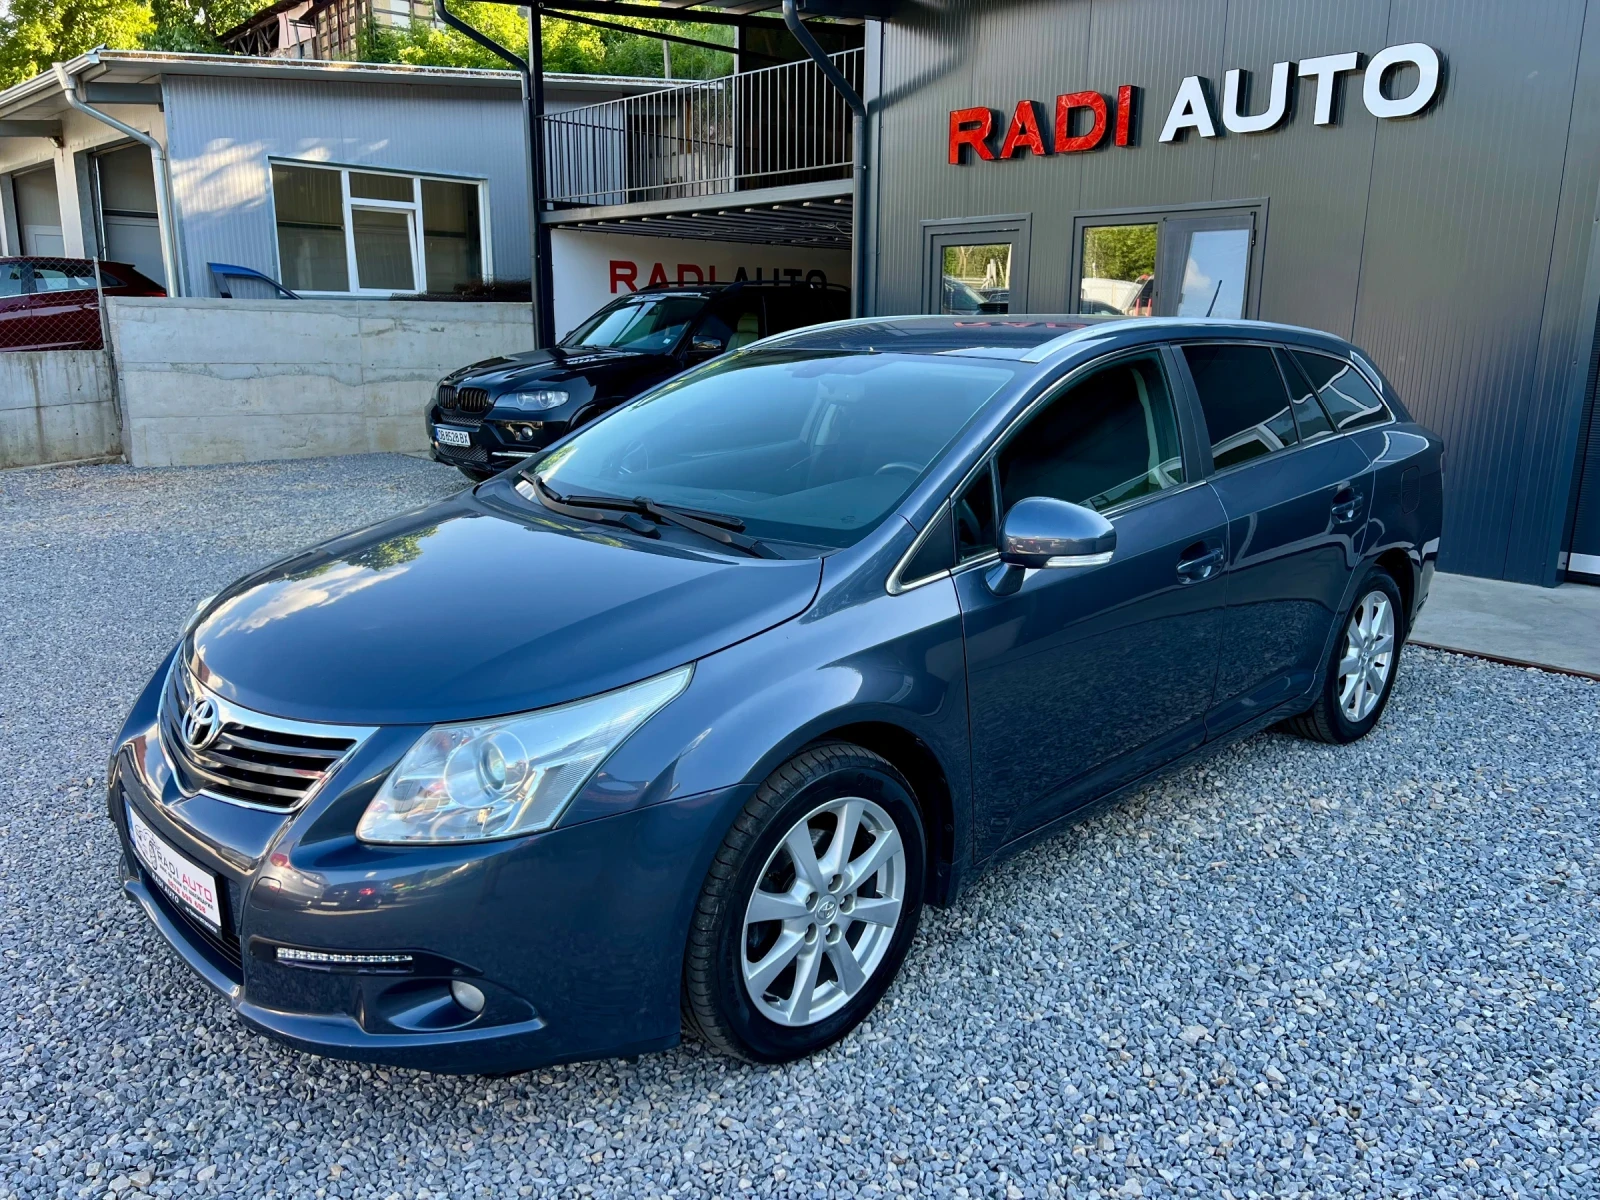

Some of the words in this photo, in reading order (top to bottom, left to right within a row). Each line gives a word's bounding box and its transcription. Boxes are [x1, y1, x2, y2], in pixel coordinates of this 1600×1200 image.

[949, 84, 1138, 165] RADI
[1158, 42, 1440, 143] AUTO
[609, 260, 716, 293] RADI
[734, 266, 828, 289] AUTO
[157, 850, 179, 878] RADI
[182, 874, 213, 903] AUTO
[164, 885, 180, 904] AUTO
